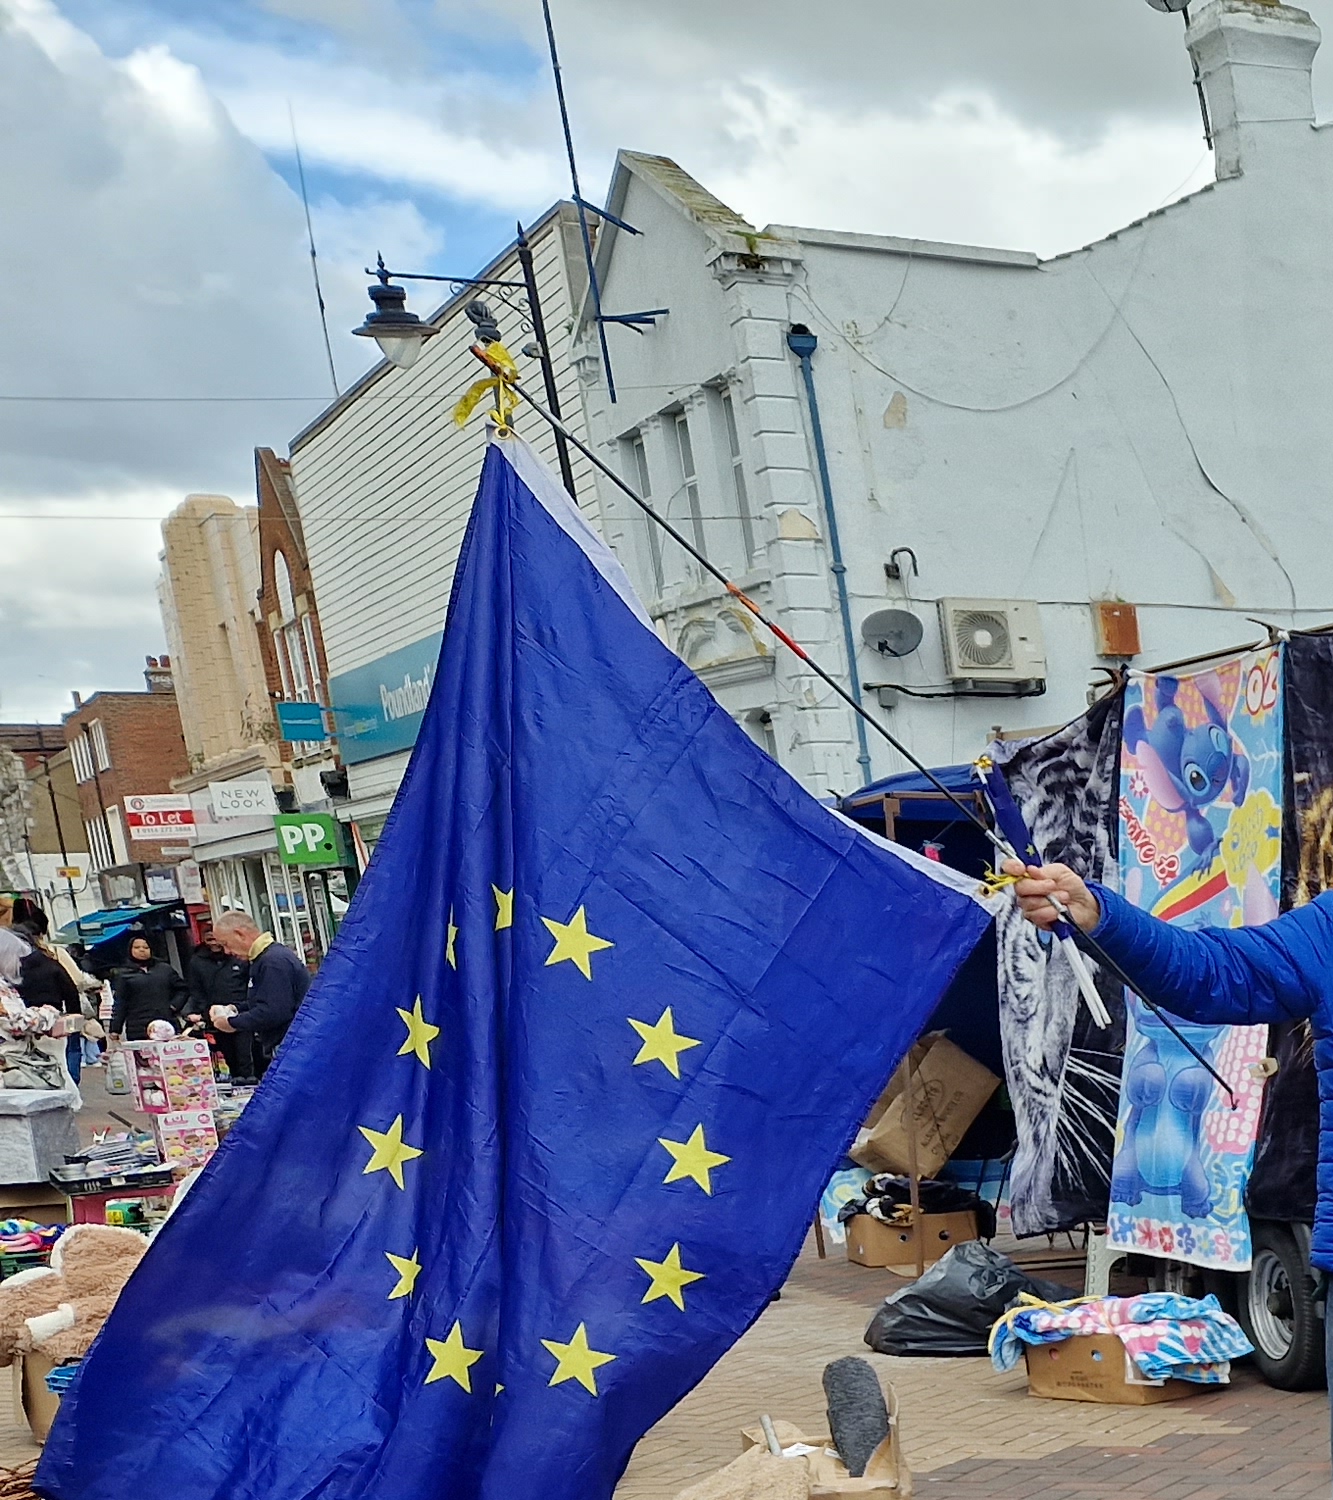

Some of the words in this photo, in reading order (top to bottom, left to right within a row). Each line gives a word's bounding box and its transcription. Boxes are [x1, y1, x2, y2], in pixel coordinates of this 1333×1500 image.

[220, 789, 261, 799] NEW
[220, 799, 267, 810] LOOK
[137, 813, 155, 825] To
[158, 812, 183, 824] Let
